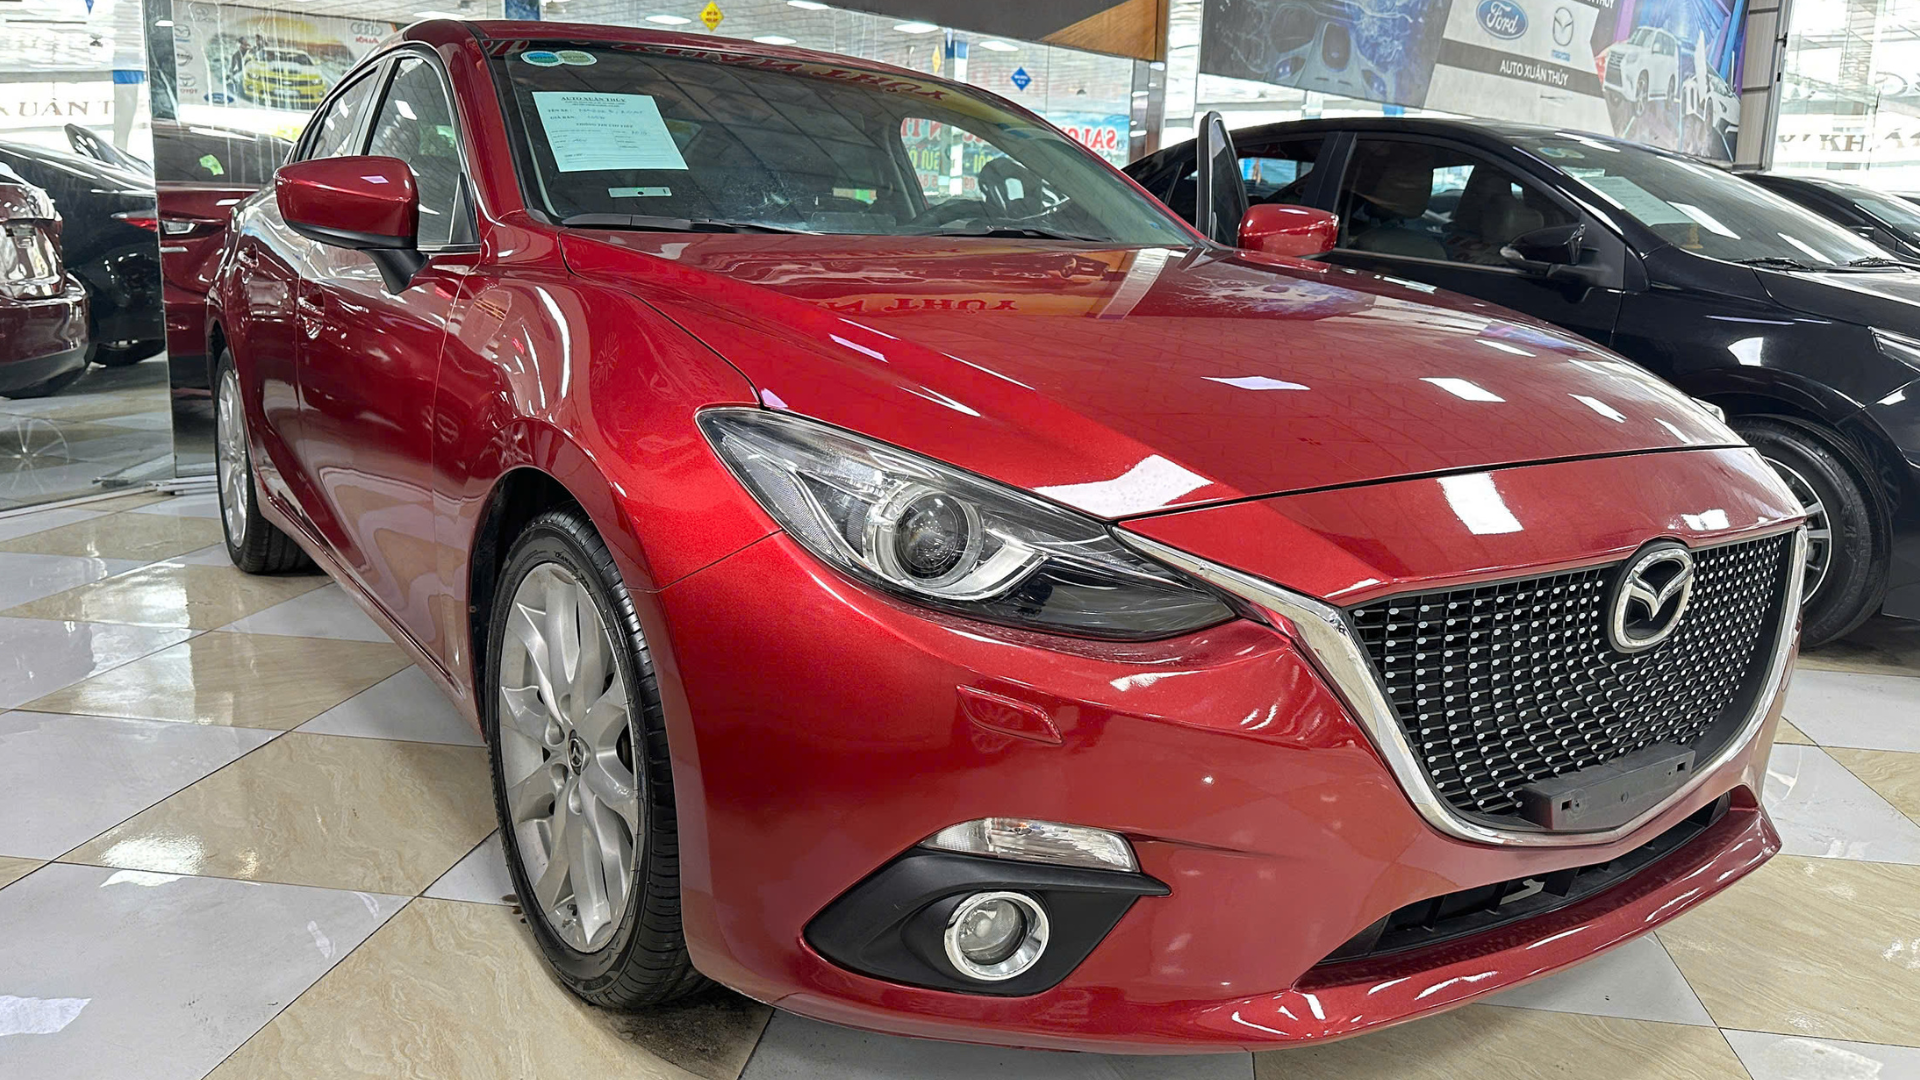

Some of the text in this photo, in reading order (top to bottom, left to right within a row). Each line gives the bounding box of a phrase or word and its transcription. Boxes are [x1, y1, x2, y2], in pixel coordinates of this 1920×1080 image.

[1486, 2, 1518, 34] Ford
[1500, 59, 1524, 77] AUTO
[1524, 64, 1548, 83] XUÂN
